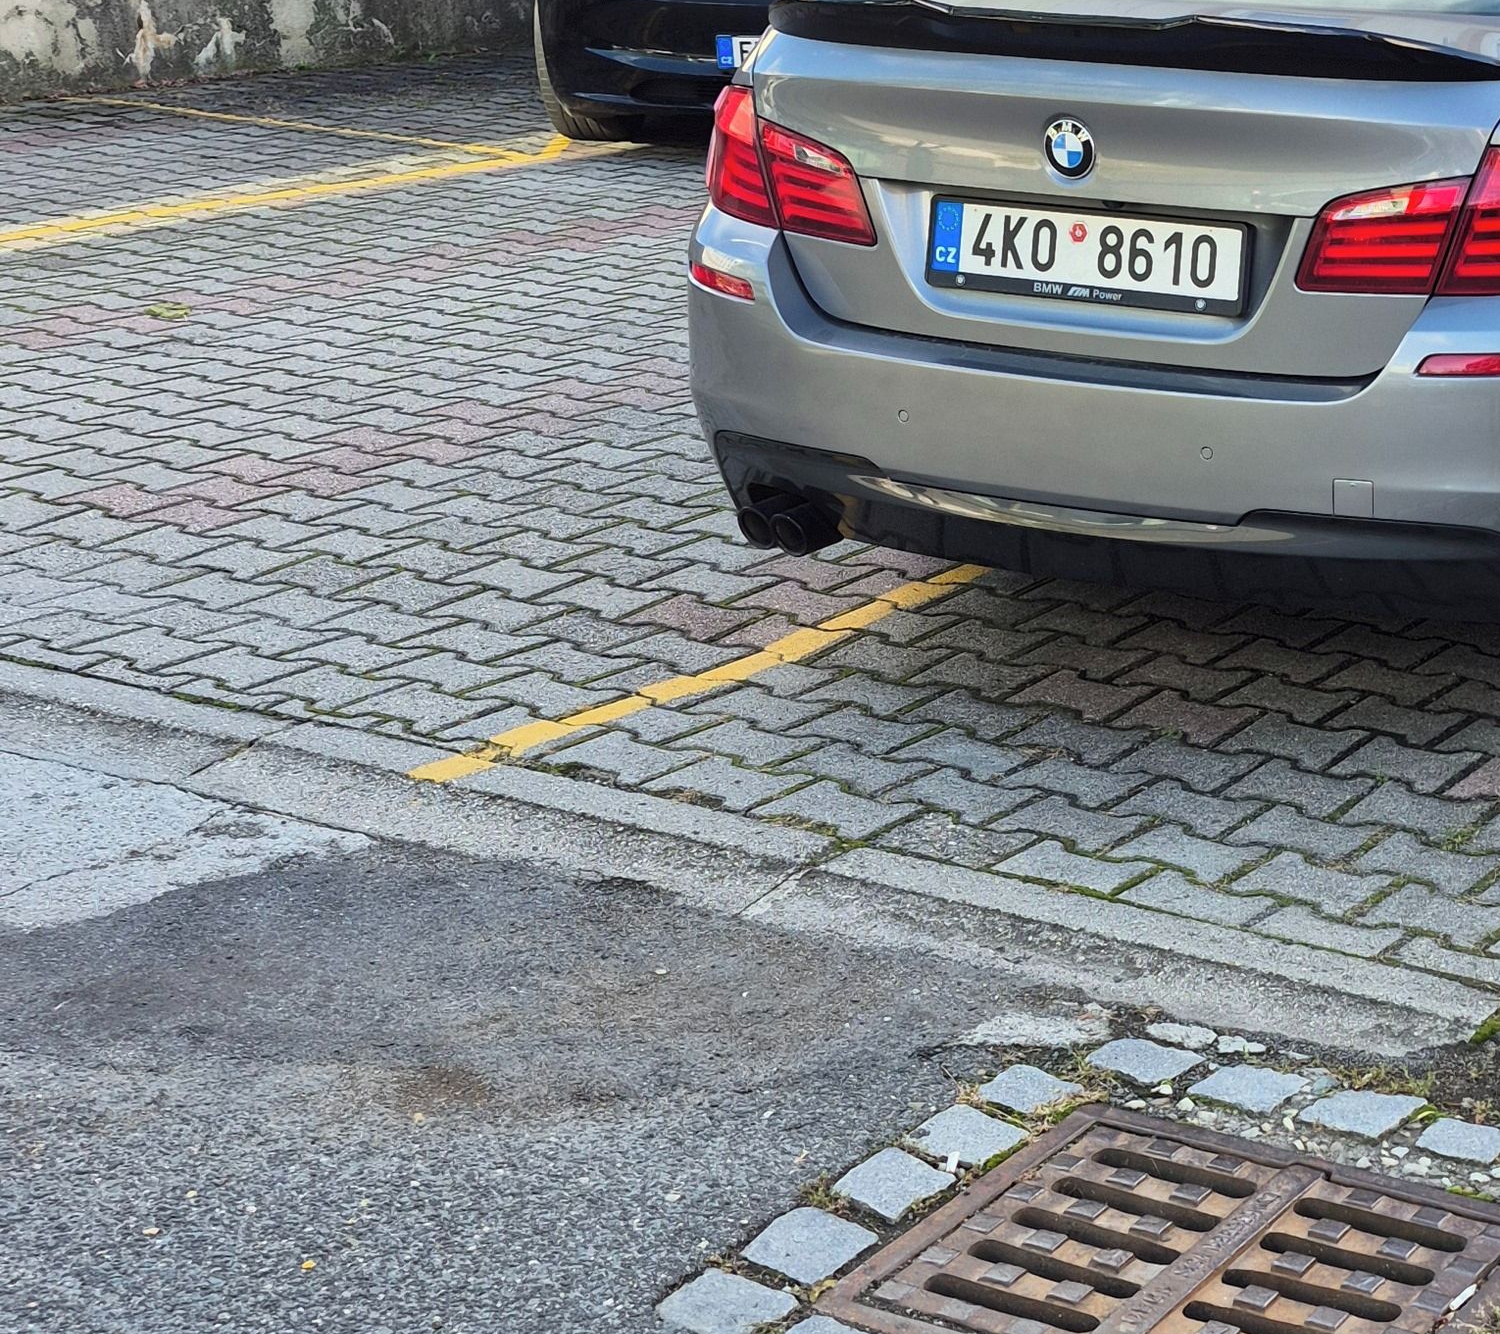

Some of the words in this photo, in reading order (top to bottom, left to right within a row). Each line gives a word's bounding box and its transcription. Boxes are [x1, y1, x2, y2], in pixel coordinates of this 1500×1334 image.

[720, 56, 733, 65] CZ
[1047, 121, 1090, 142] BMW
[935, 246, 956, 264] CZ
[1097, 224, 1218, 288] 8610
[1033, 282, 1063, 295] BMW
[1092, 288, 1122, 301] Power
